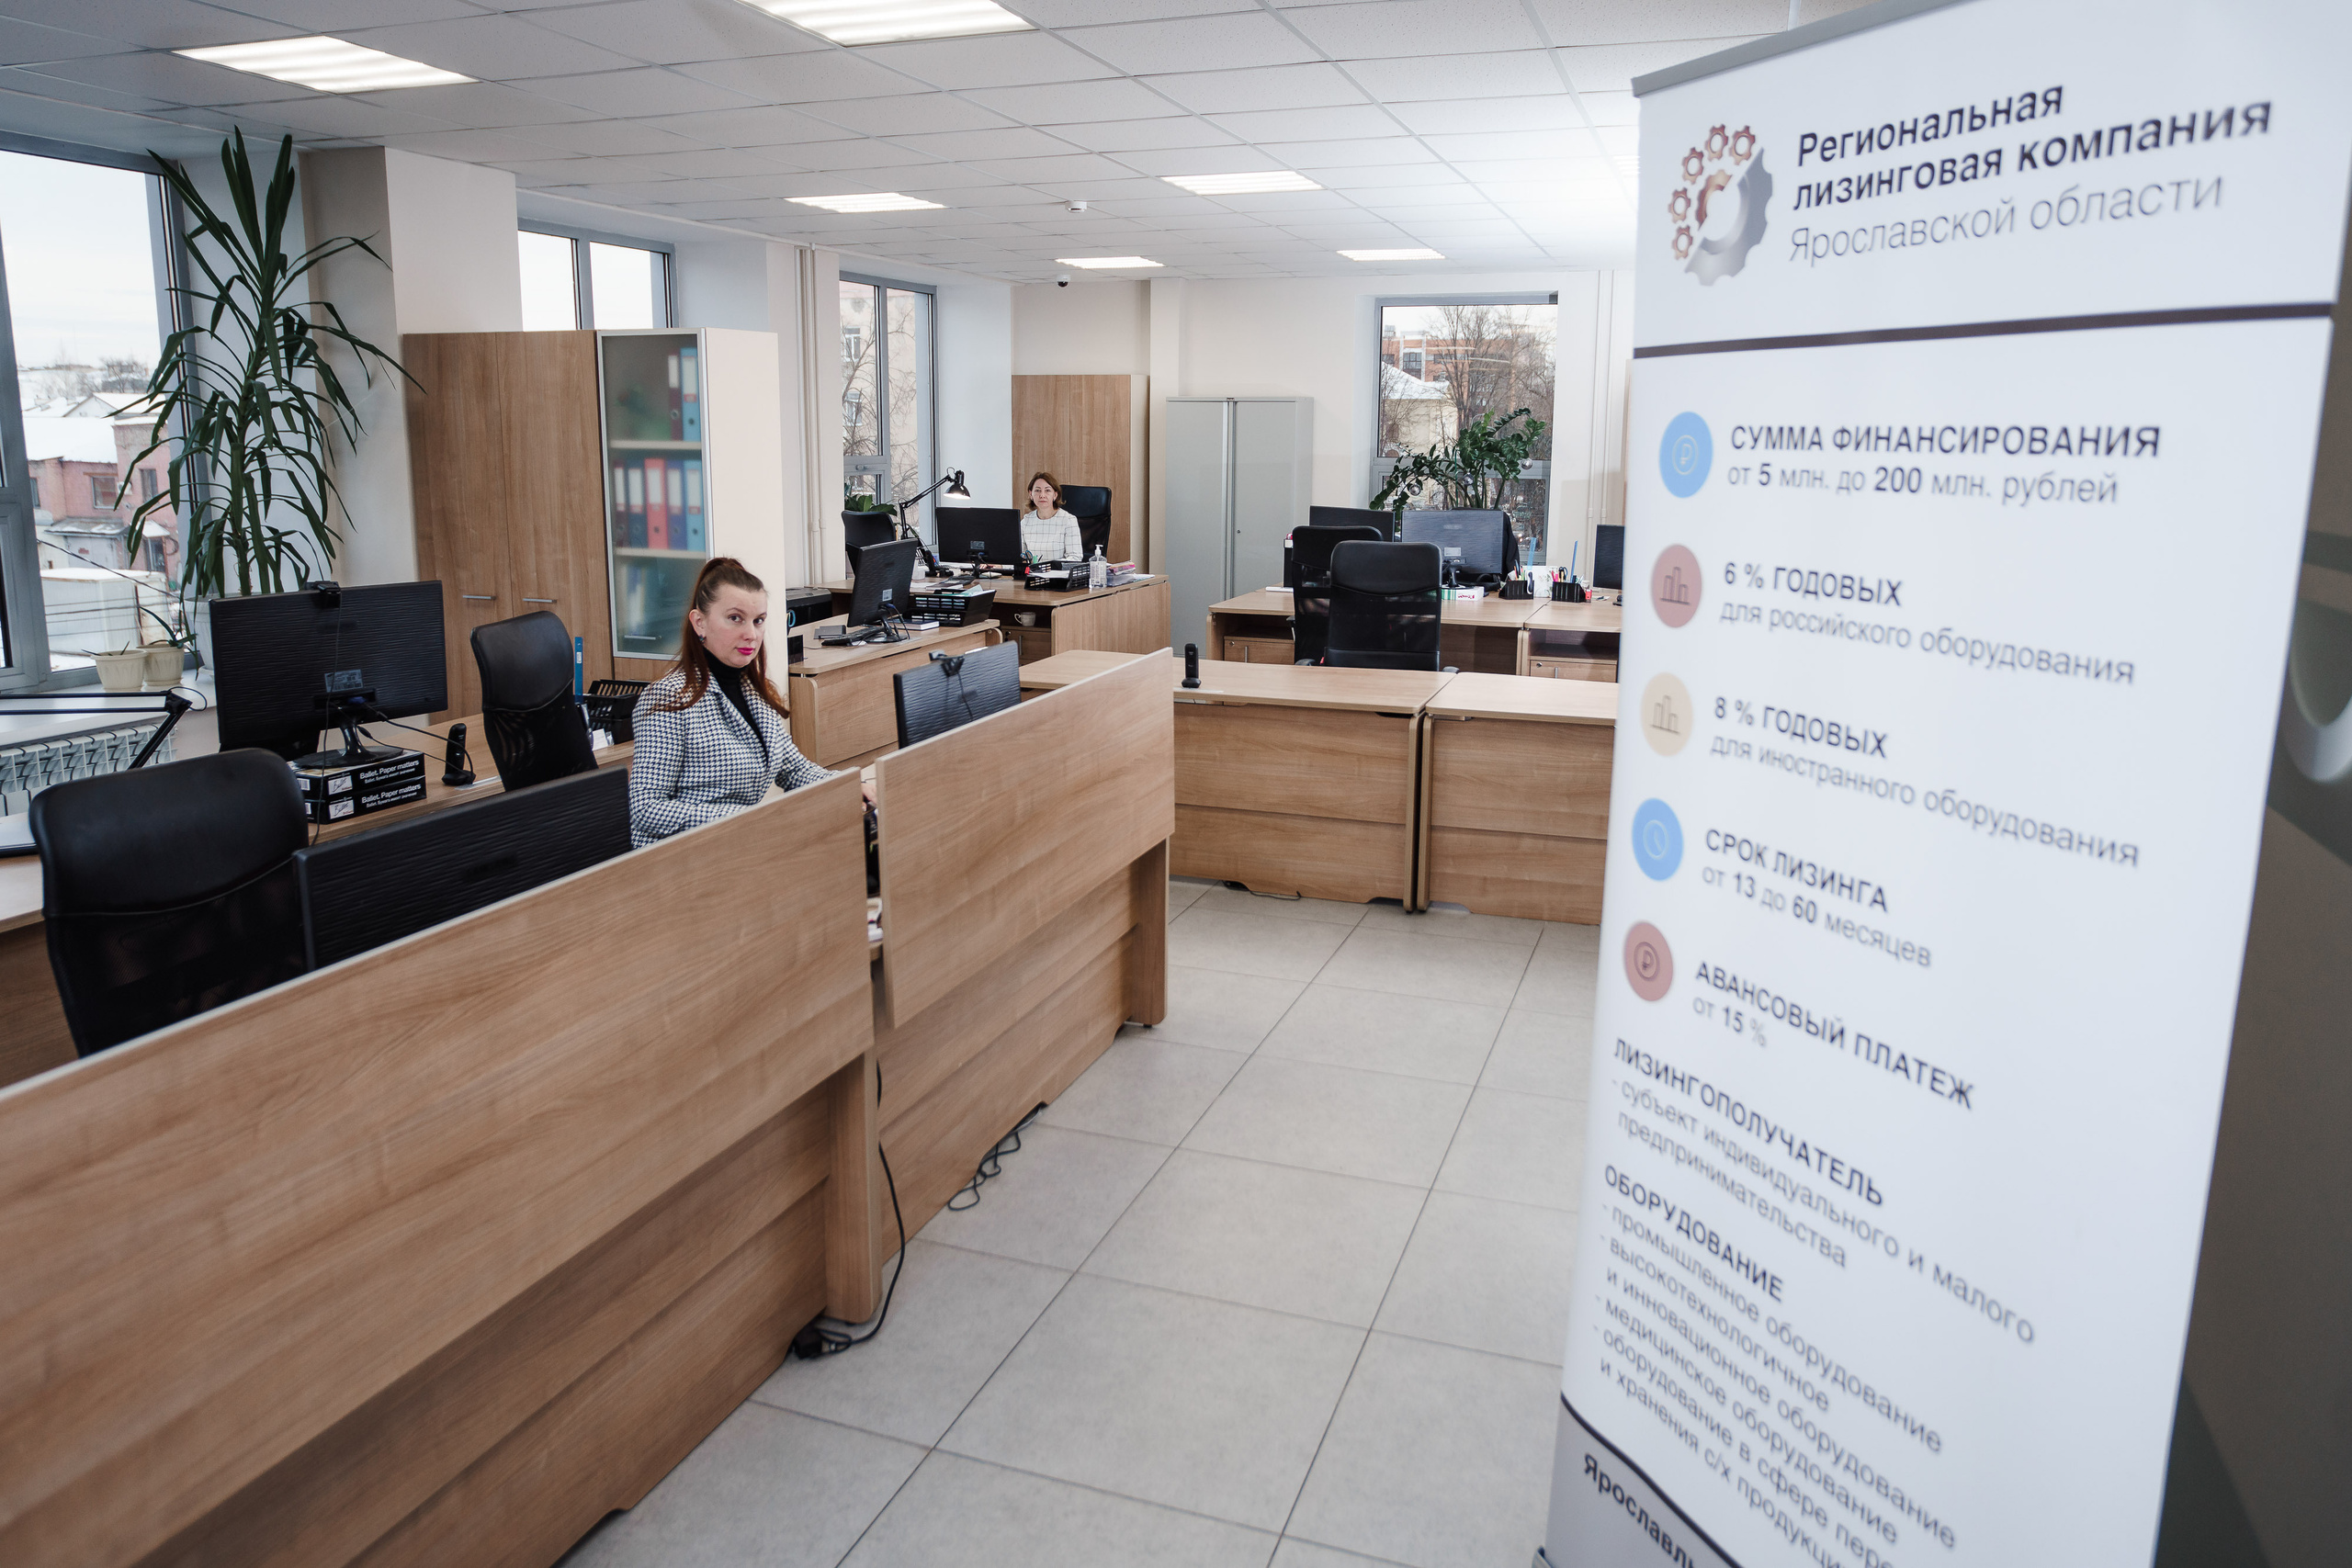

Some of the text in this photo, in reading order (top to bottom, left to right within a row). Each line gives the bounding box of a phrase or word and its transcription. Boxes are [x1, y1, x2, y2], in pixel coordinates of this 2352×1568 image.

[1793, 100, 2272, 210] лизинговая компания
[1798, 85, 2063, 167] Региональная
[1790, 176, 2223, 267] Ярославской области
[1727, 462, 2117, 506] от 5 млн. до 200 млн. рублей
[1731, 425, 2161, 457] СУММА ФИНАНСИРОВАНИЯ
[1724, 561, 1903, 607] 6 % ГОДОВЫХ
[1719, 602, 2135, 685] для российского оборудования
[379, 765, 397, 775] Paper
[397, 760, 420, 771] matters
[1714, 695, 1887, 759] 8 % ГОДОВЫХ
[380, 789, 398, 799] Paper
[399, 784, 422, 794] matters
[1709, 735, 2139, 867] для иностранного оборудования
[1702, 865, 1932, 968] от 13 до 60 месяцев
[1705, 829, 1889, 913] СРОК ЛИЗИНГА
[1692, 996, 1768, 1048] от 15 %
[1695, 961, 1974, 1111] АВАНСОВЫЙ ПЛАТЕЖ
[1613, 1037, 1883, 1207] ЛИЗИНГОПОЛУЧАТЕЛЬ
[1604, 1164, 1783, 1303] ОБОРУДОВАНИЕ
[1617, 1110, 1847, 1269] предпринимательства
[1622, 1078, 1699, 1134] субъект
[1703, 1122, 1900, 1258] индивидуального
[1907, 1247, 1925, 1274] и
[1932, 1263, 2035, 1344] малого
[1610, 1235, 1830, 1412] высокотехнологичное
[1612, 1205, 1760, 1323] промышленное
[1765, 1315, 1942, 1453] оборудование
[1600, 1356, 1611, 1378] и
[1616, 1367, 1700, 1453] хранения
[1704, 1445, 1733, 1484] с/х
[1602, 1327, 1733, 1449] оборудование
[1739, 1442, 1751, 1462] в
[1757, 1456, 1829, 1529] сфере
[1605, 1298, 1726, 1406] медицинское
[1732, 1399, 1898, 1546] оборудование
[1607, 1267, 1956, 1551] и инновационное оборудование
